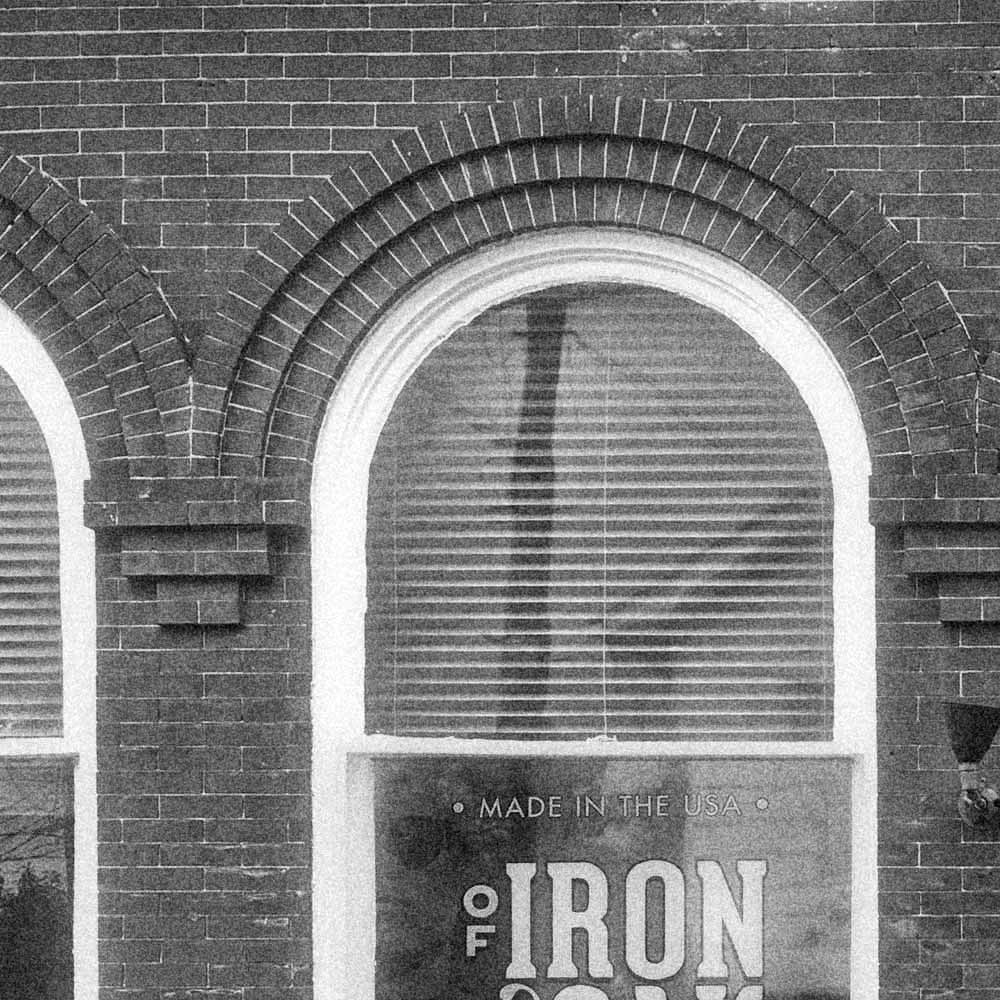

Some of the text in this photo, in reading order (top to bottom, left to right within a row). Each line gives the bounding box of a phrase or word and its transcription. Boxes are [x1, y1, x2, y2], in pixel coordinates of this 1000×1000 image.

[479, 794, 742, 818] MADE IN THE USA
[463, 884, 499, 957] OF
[505, 859, 767, 980] IRON
